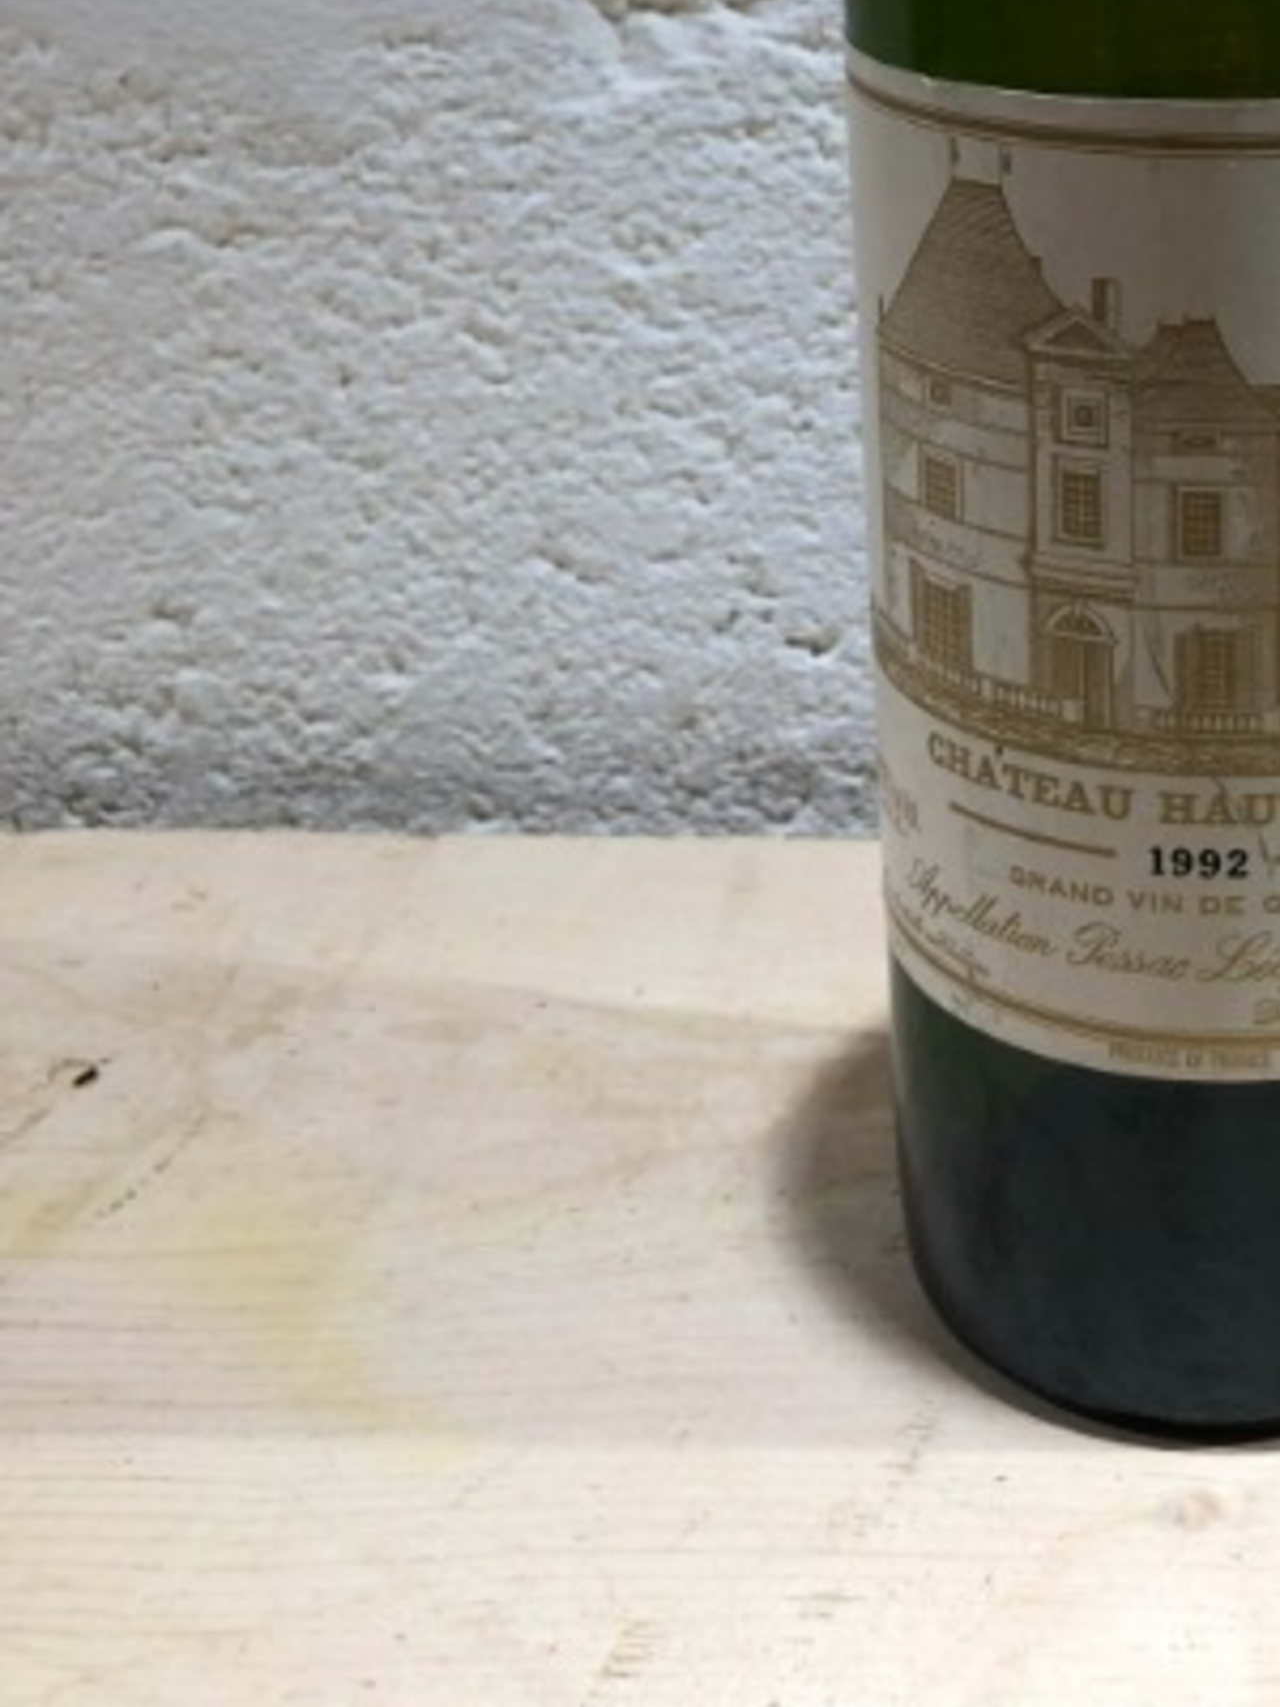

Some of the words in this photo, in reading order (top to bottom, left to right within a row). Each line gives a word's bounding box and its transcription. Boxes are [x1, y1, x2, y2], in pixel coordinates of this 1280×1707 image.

[1148, 846, 1250, 880] 1992
[905, 856, 1056, 958] Appellation
[1008, 864, 1114, 908] GRAND
[1126, 889, 1184, 914] VIN
[1200, 894, 1245, 916] DE
